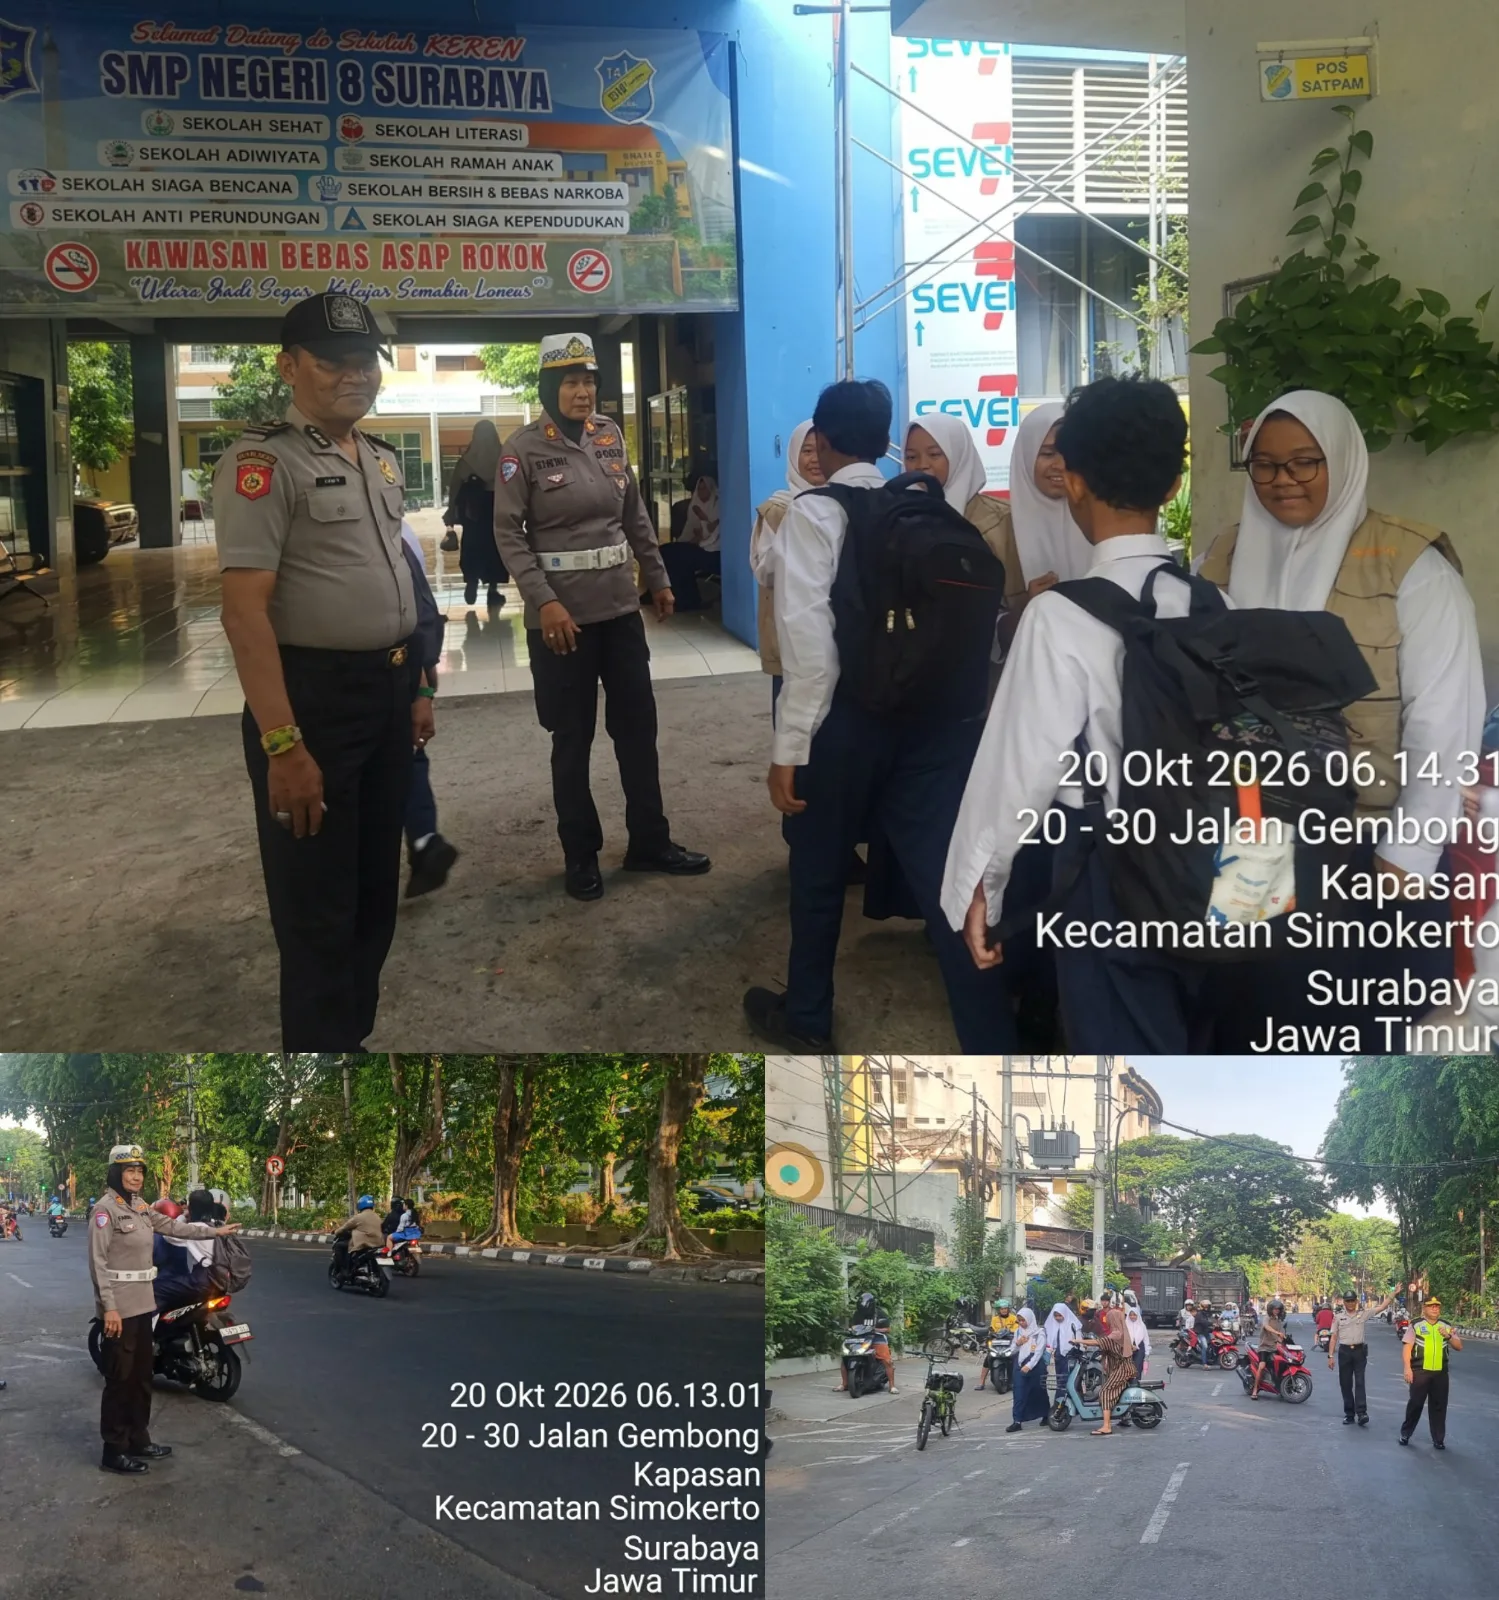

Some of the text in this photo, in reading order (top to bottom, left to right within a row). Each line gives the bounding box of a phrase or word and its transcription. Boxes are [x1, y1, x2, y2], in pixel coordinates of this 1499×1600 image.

[131, 20, 221, 45] Selamat
[225, 24, 301, 55] Datang
[336, 29, 417, 54] Sekolah
[424, 34, 526, 61] KEREN
[1316, 61, 1348, 74] POS
[102, 50, 191, 98] SMP
[199, 54, 330, 103] NEGERI
[336, 59, 365, 106] 8
[374, 60, 552, 113] SURABAYA
[1302, 77, 1364, 92] SATPAM
[183, 117, 323, 134] SEKOLAH SEHAT
[375, 124, 522, 141] SEKOLAH LITERASI
[139, 148, 320, 164] SEKOLAH ADIWIYATA
[370, 154, 554, 171] SEKOLAH RAMAH ANAK
[62, 178, 292, 194] SEKOLAH SIAGA BENCANA
[347, 183, 624, 200] SEKOLAH BERSIH & BEBAS NARKOBA
[52, 208, 320, 225] SEKOLAH ANTI PERUNDUNGAN
[372, 213, 624, 229] SEKOLAH SIAGA KEPENDUDUKAN
[124, 239, 548, 272] KAWASAN BEBAS ASAP ROKOK
[205, 277, 254, 303] Jadi
